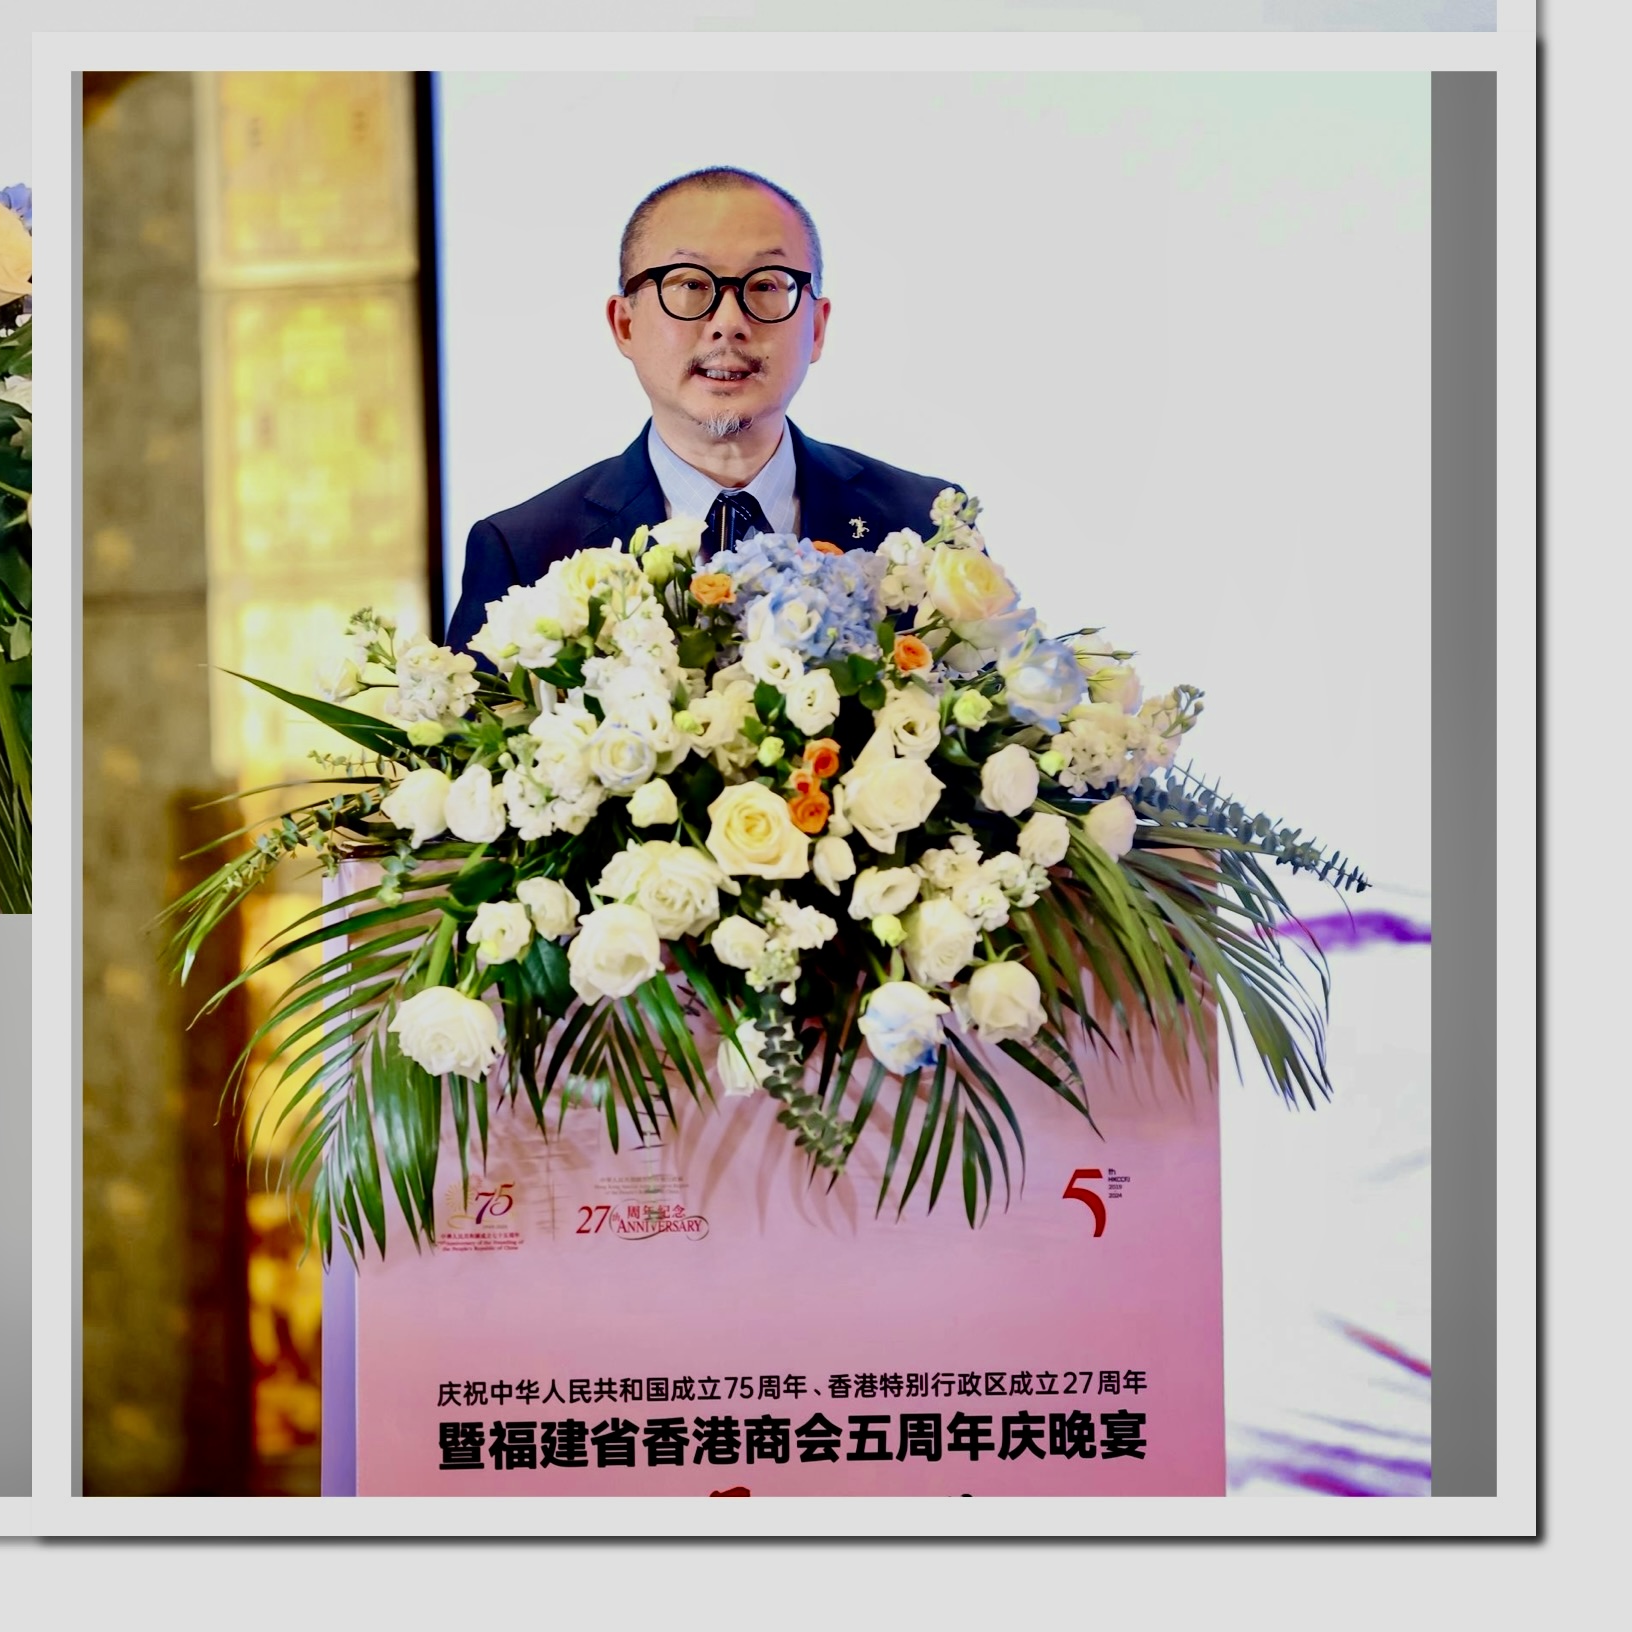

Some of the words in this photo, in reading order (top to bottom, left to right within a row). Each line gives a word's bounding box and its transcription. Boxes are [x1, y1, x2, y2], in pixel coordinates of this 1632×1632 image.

[475, 1180, 515, 1225] 75
[1062, 1168, 1106, 1237] 5
[437, 1369, 1148, 1407] 庆祝中华人民共和国成立75周年、香港特别行政区成立27周年
[438, 1409, 1147, 1471] 暨福建省香港商会五周年庆晚宴
